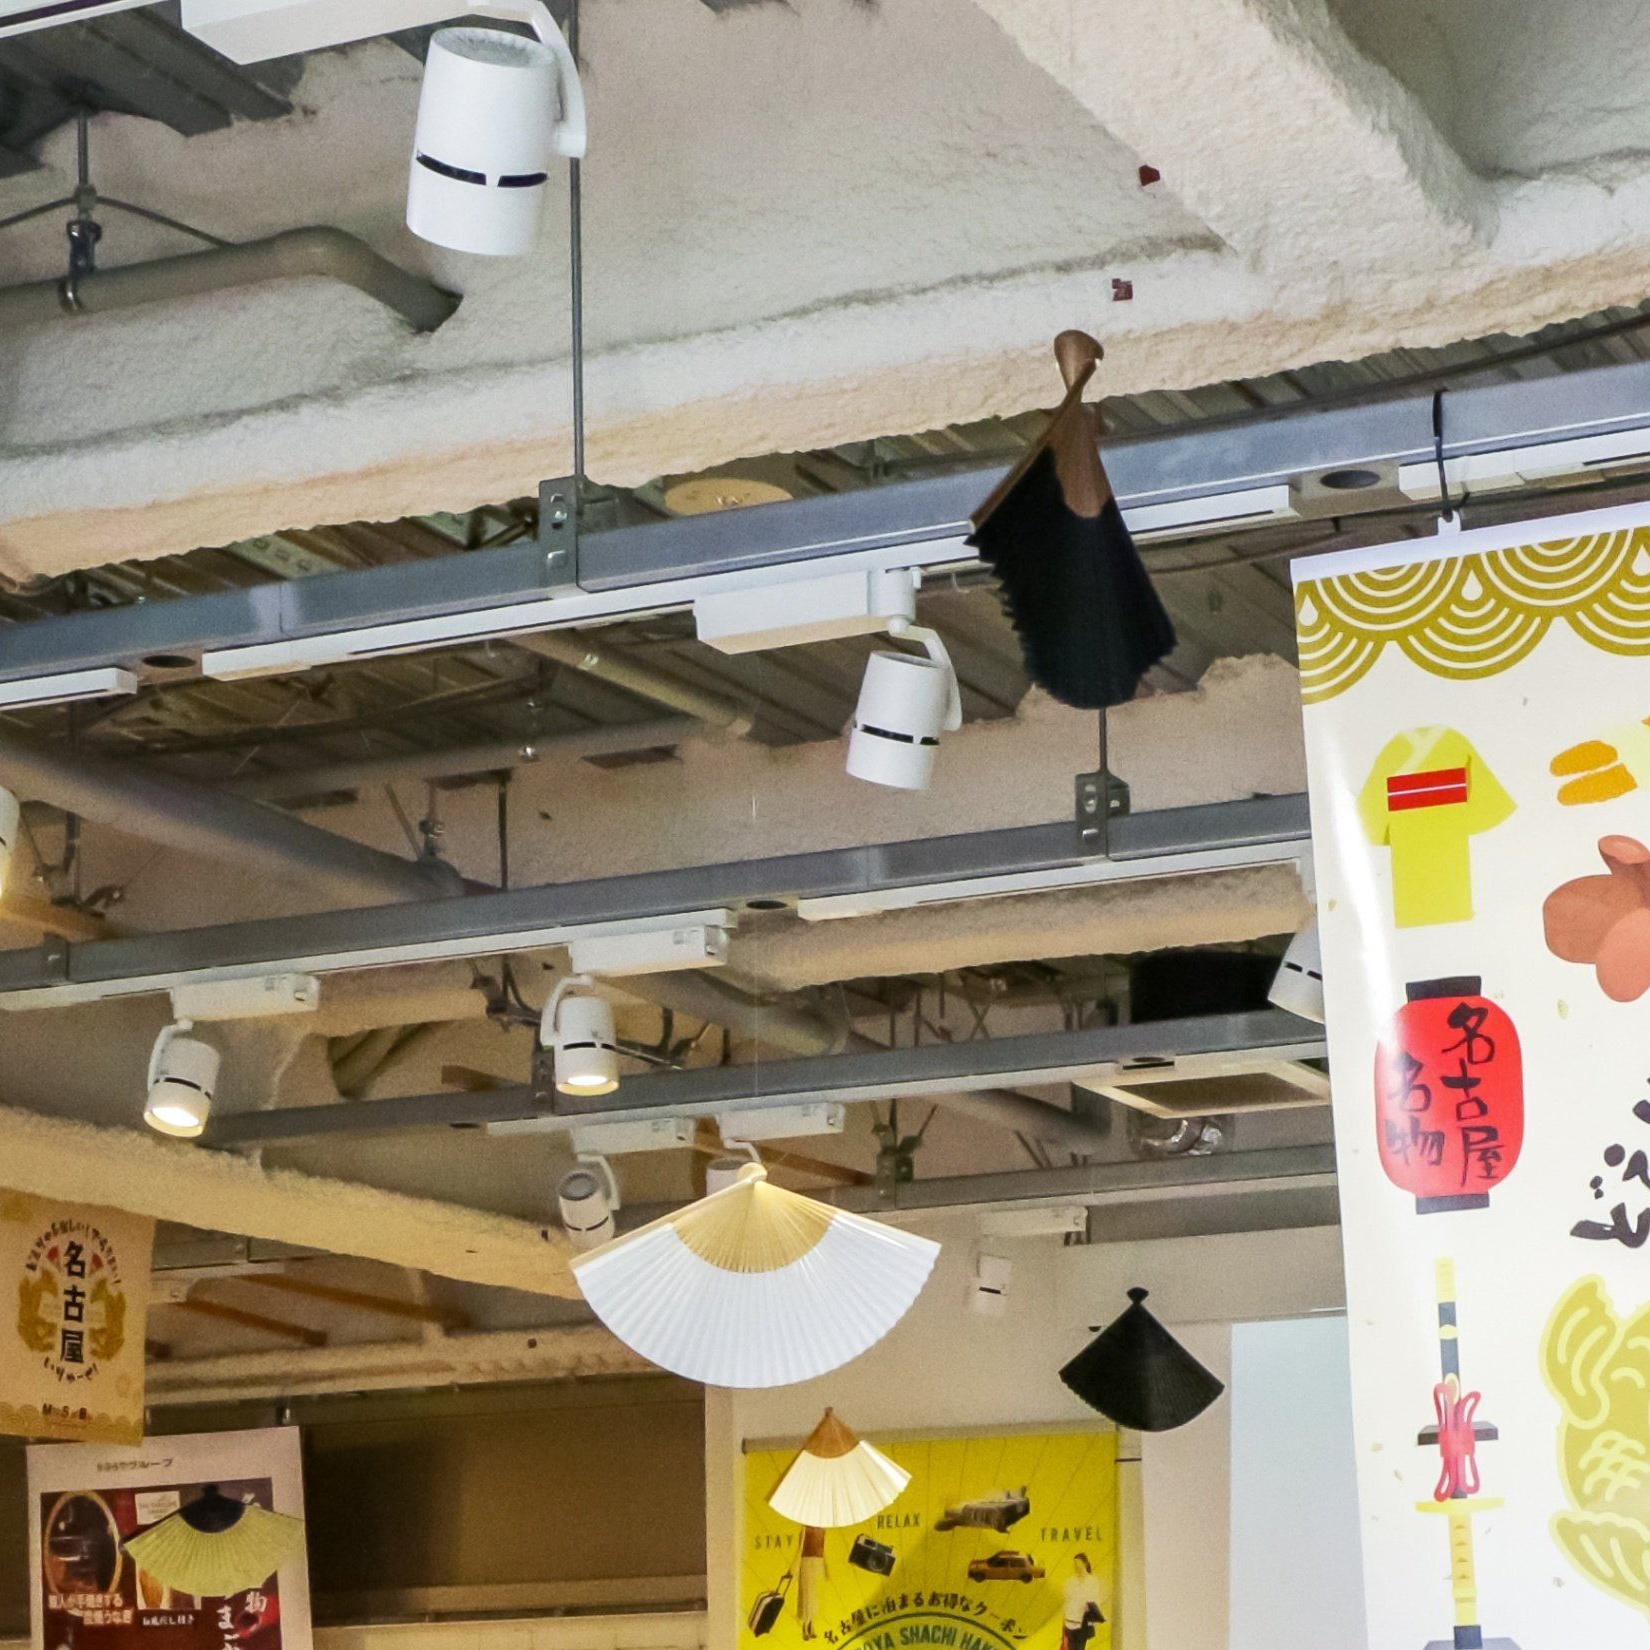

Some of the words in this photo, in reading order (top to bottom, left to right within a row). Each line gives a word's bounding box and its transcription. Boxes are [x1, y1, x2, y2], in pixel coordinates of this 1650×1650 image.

[1440, 1003, 1503, 1187] 名古屋
[1383, 1052, 1445, 1168] 名物
[60, 1241, 86, 1364] 名古屋
[876, 1512, 921, 1531] RELAX
[753, 1534, 793, 1551] STAY
[1040, 1526, 1103, 1543] TRAVEL
[899, 1624, 957, 1647] SHACHI
